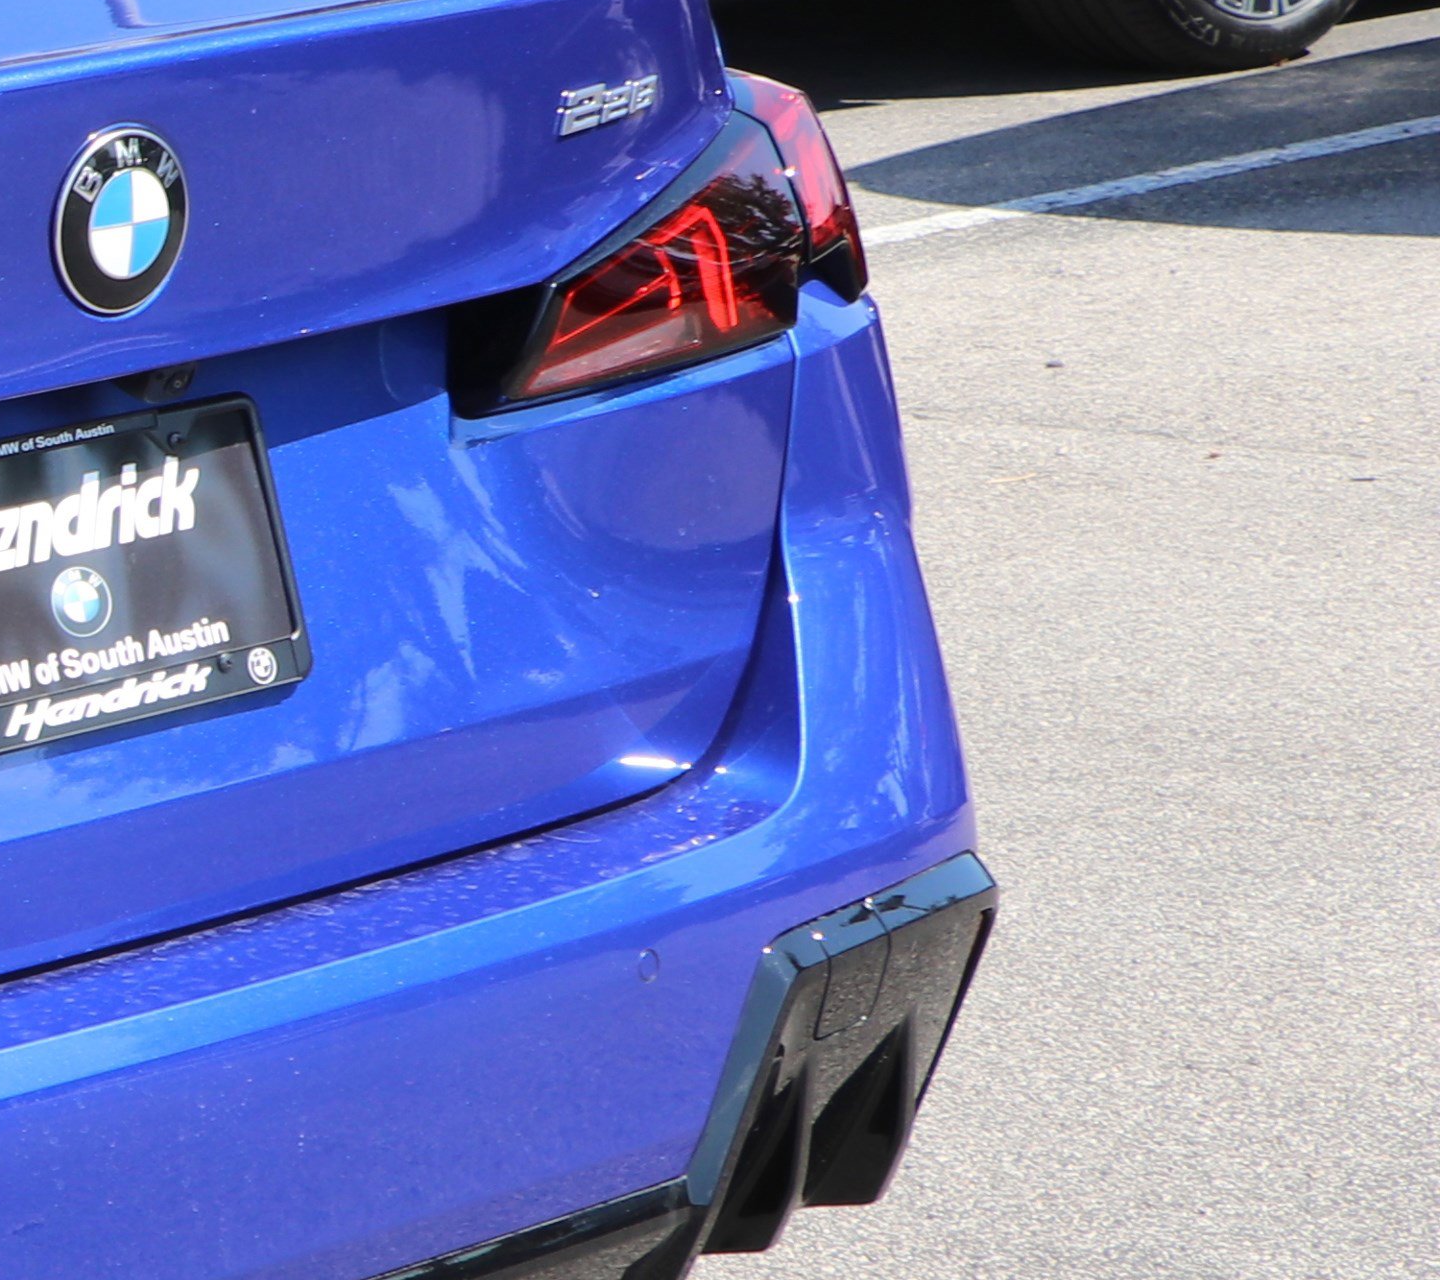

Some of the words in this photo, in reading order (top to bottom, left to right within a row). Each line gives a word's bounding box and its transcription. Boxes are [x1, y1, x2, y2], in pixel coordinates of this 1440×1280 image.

[73, 137, 180, 203] BMW
[21, 437, 36, 453] of
[36, 430, 74, 451] South
[75, 423, 115, 444] Austin
[37, 652, 62, 685] of
[63, 633, 145, 677] South
[146, 618, 230, 659] Austin
[5, 662, 212, 742] Hendrick
